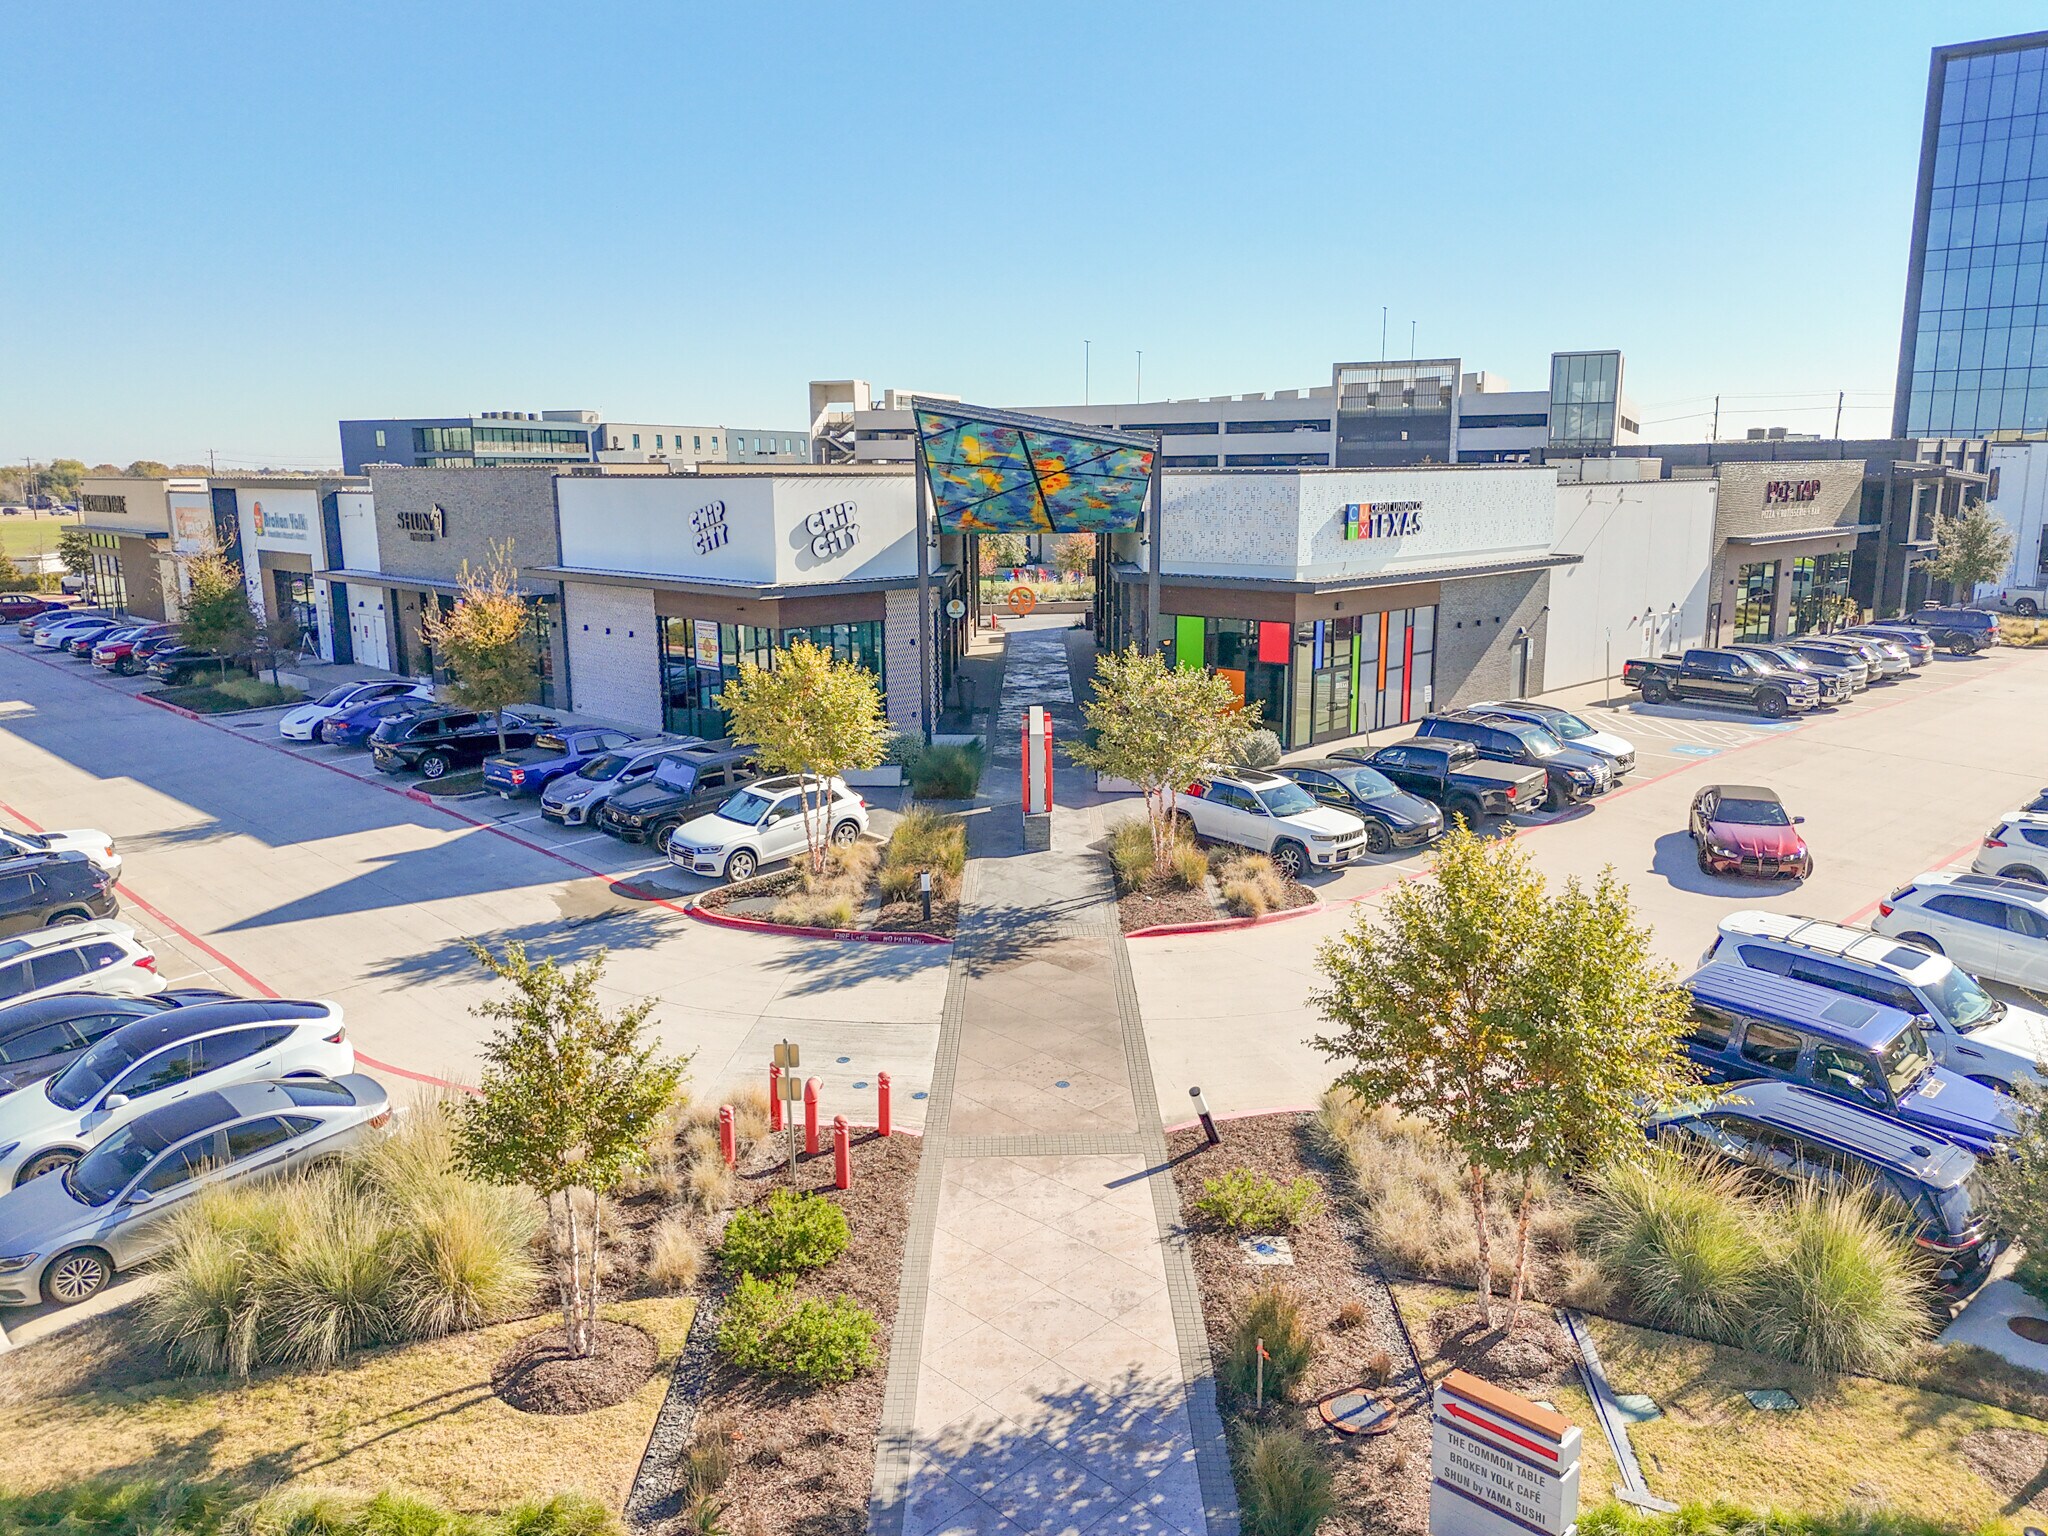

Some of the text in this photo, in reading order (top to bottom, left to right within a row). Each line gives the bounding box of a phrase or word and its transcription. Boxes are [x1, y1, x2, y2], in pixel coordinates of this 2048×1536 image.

[1795, 480, 1821, 501] TAP
[1393, 501, 1414, 512] UNION
[264, 512, 288, 529] Broken
[289, 513, 308, 530] Yolk
[397, 512, 434, 531] SHUN
[1370, 512, 1423, 538] TEXAS
[834, 932, 850, 940] FIRE
[851, 933, 870, 941] LANE
[1447, 1432, 1546, 1488] THE COMMON TABLE
[1449, 1451, 1541, 1504] BROKEN YOLK CAFÉ
[1444, 1466, 1546, 1525] SHUN by YAMA SUSHI
